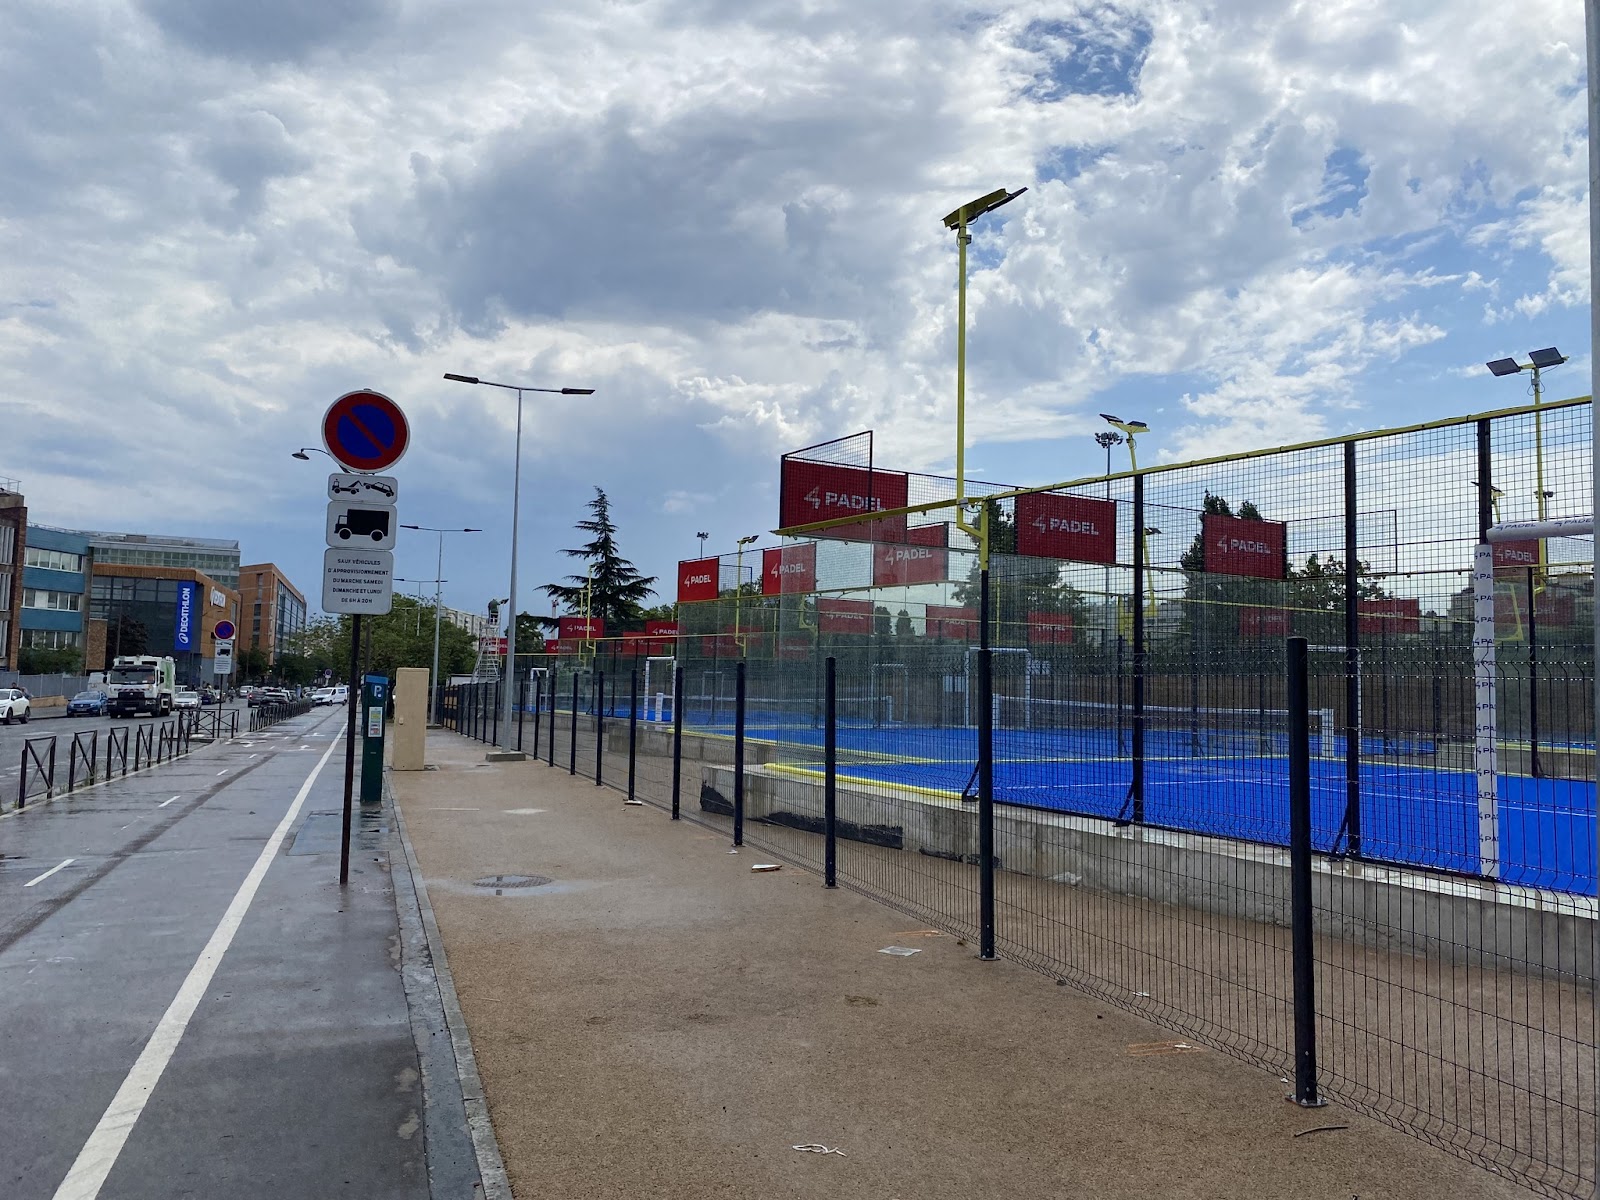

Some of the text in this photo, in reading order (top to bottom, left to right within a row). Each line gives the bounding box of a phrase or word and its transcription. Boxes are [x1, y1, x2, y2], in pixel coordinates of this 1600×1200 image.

[825, 491, 887, 512] PADEL
[1050, 518, 1099, 536] PADEL
[1230, 539, 1271, 554] PADEL
[896, 548, 933, 561] PADEL
[1504, 549, 1536, 563] PADEL
[779, 563, 806, 575] PADEL
[690, 574, 712, 585] PADEL
[180, 587, 191, 633] DECATHLON
